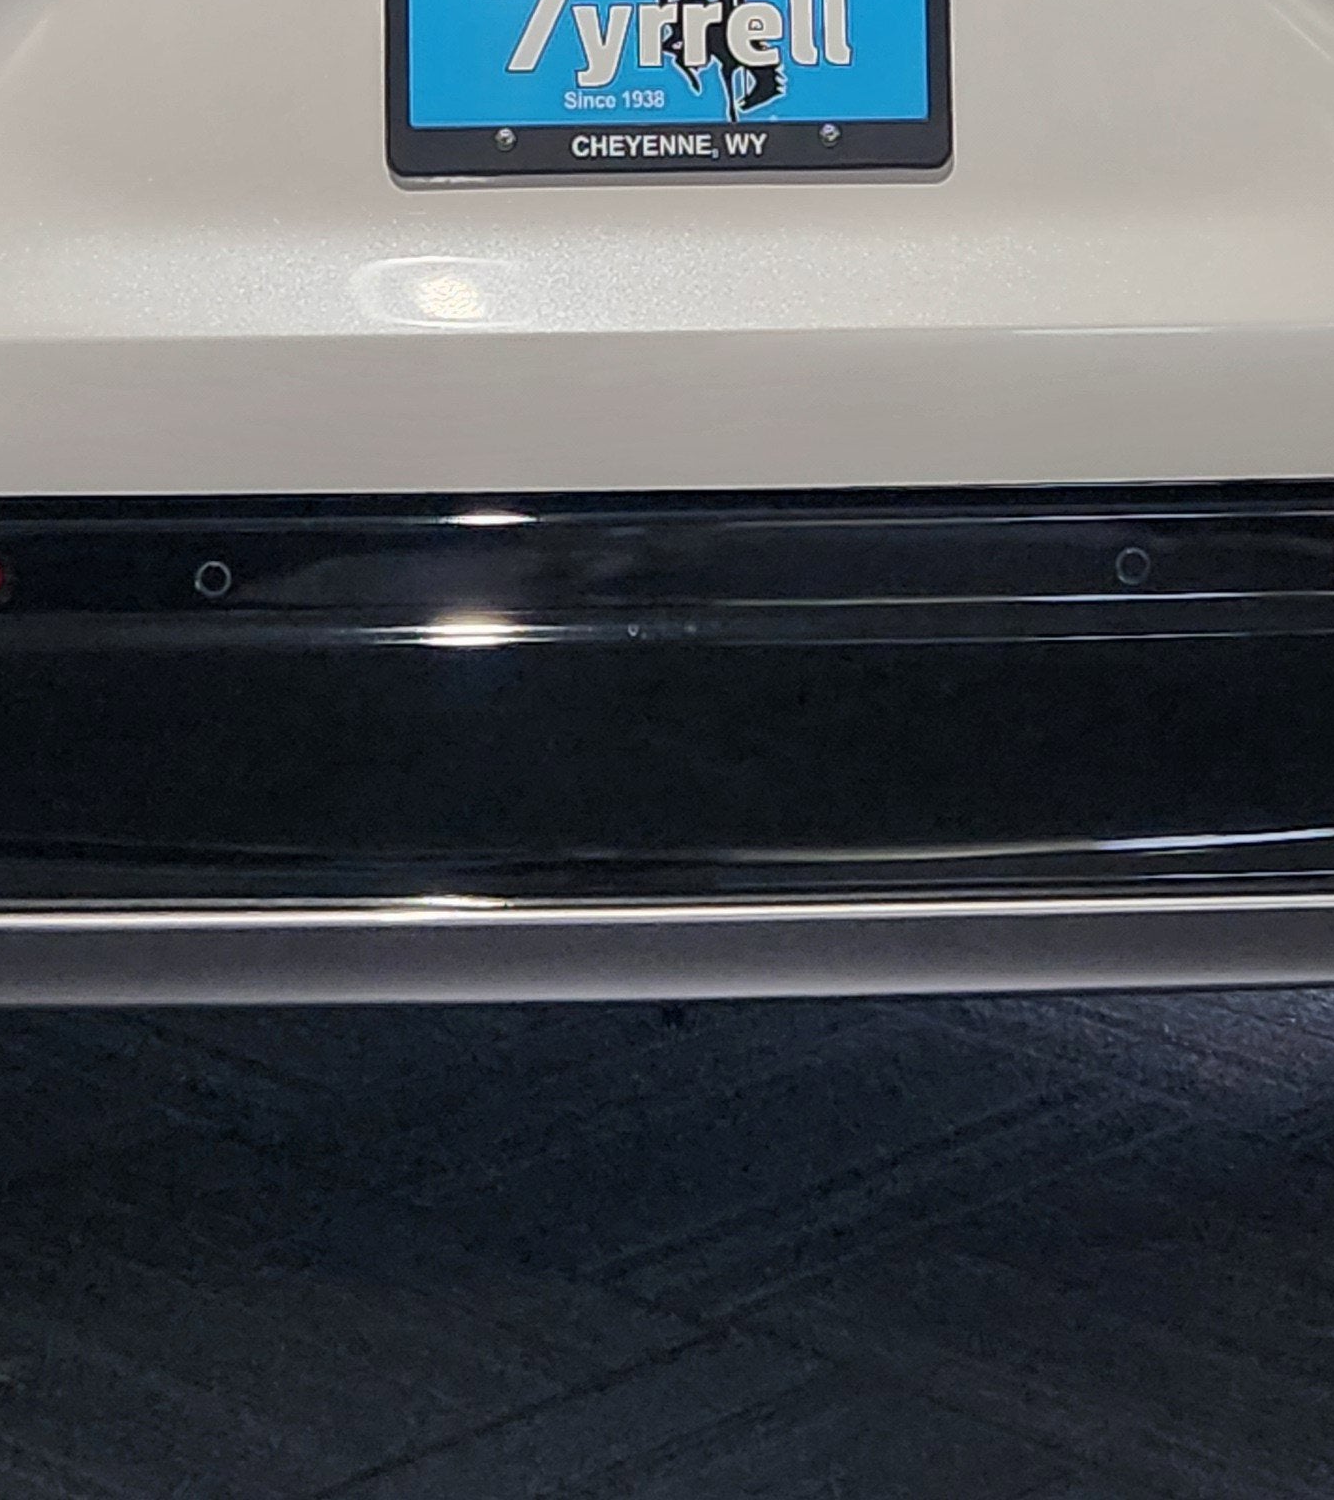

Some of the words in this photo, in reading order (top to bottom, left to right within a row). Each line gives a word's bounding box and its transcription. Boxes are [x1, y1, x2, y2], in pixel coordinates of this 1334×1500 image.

[563, 91, 617, 110] Since
[621, 90, 666, 109] 1938
[571, 134, 720, 159] CHEYENNE,
[725, 133, 768, 156] WY
